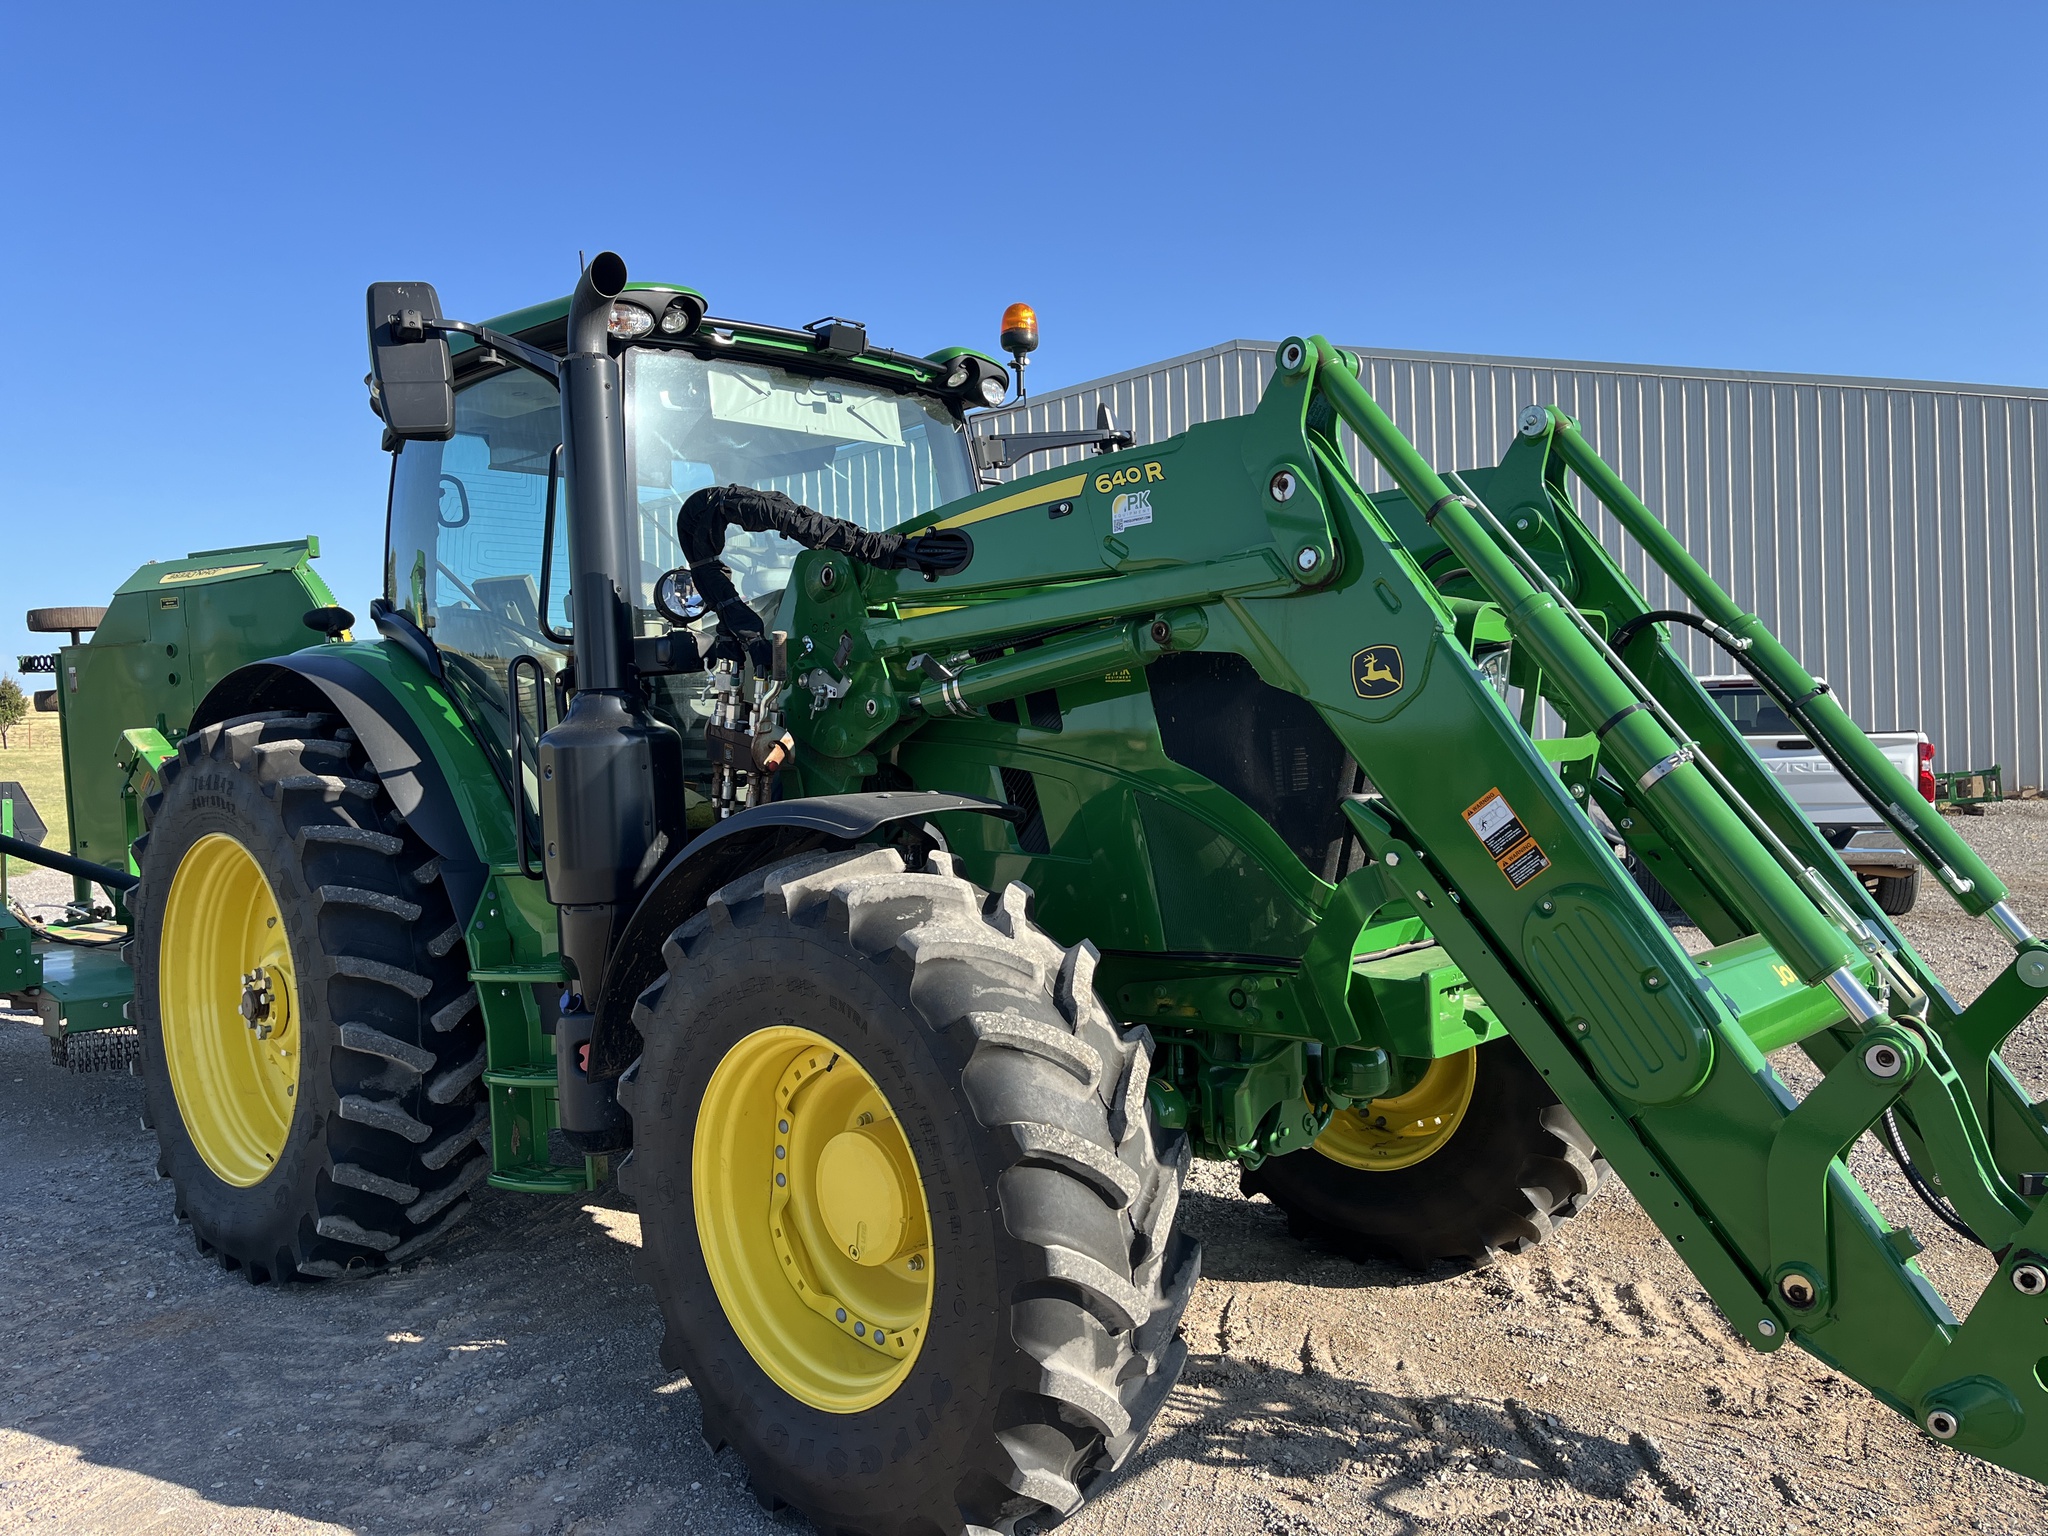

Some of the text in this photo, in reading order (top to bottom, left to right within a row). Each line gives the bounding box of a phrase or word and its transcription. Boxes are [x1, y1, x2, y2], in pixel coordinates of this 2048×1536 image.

[1472, 792, 1495, 812] WARNING
[1508, 842, 1532, 861] WARNING
[1772, 964, 1799, 987] JO
[828, 995, 869, 1036] EXTRA
